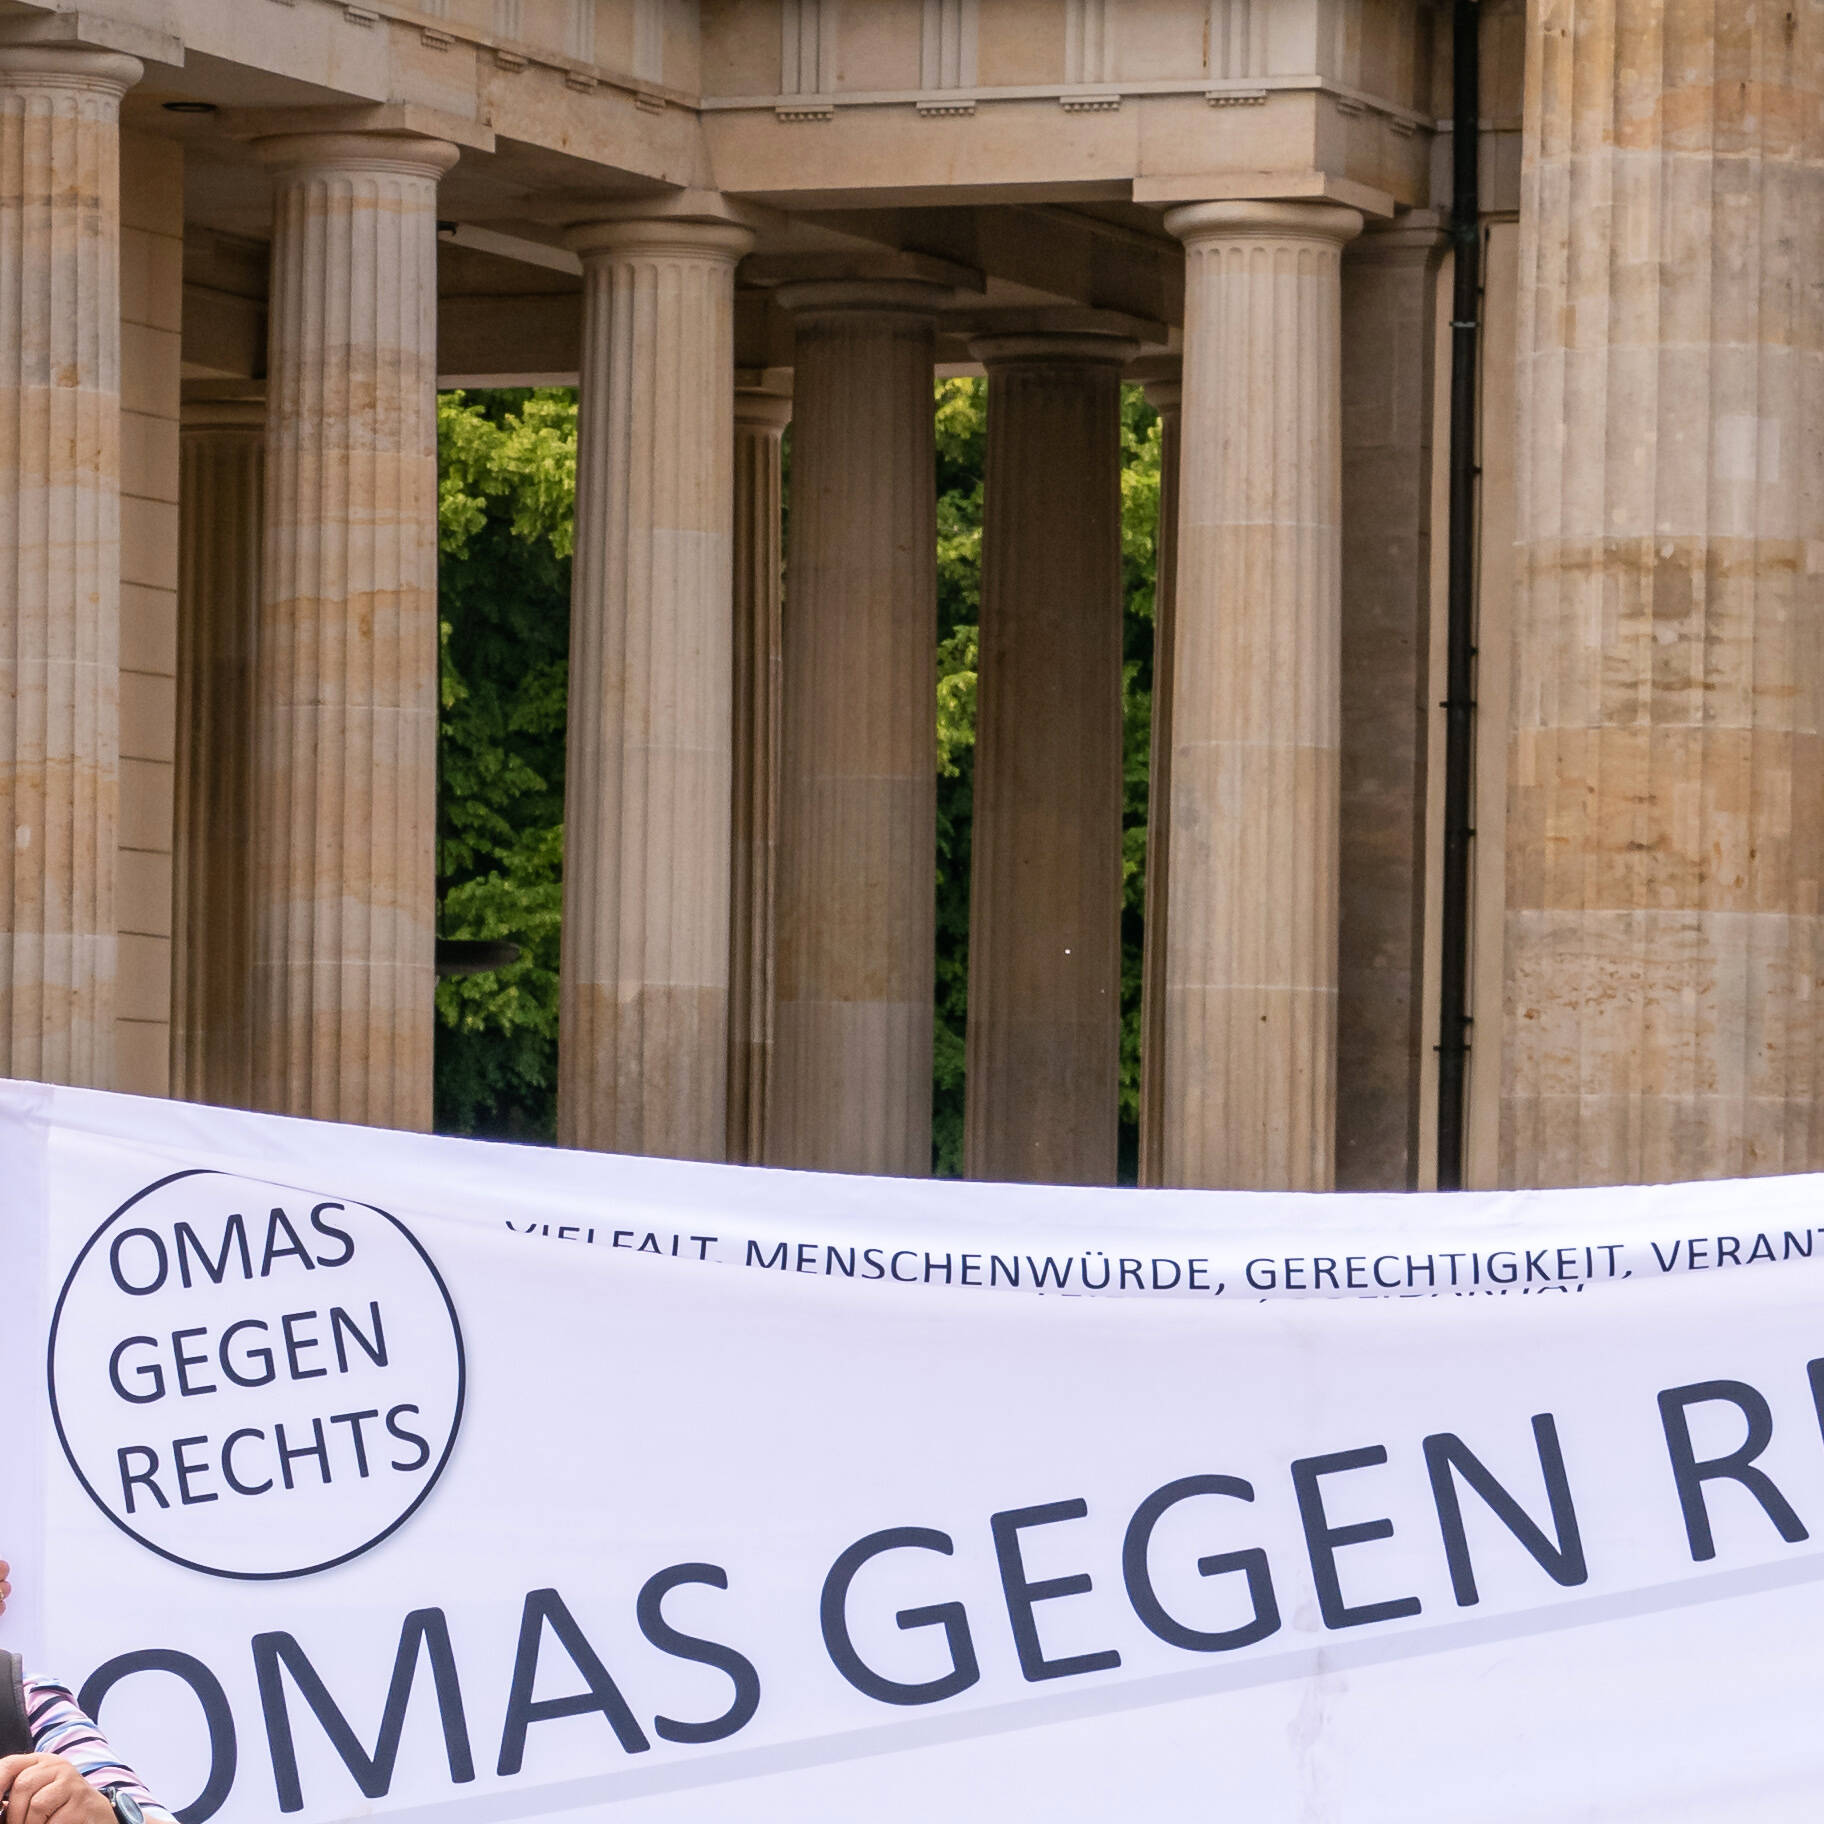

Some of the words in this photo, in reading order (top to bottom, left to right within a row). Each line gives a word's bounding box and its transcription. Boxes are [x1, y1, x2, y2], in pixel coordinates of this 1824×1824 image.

[109, 1202, 355, 1297] OMAS
[744, 1239, 1228, 1297] MENSCHENWÜRDE,
[1244, 1242, 1634, 1293] GERECHTIGKEIT,
[108, 1301, 389, 1404] GEGEN
[117, 1403, 430, 1514] RECHTS
[820, 1412, 1588, 1706] GEGEN
